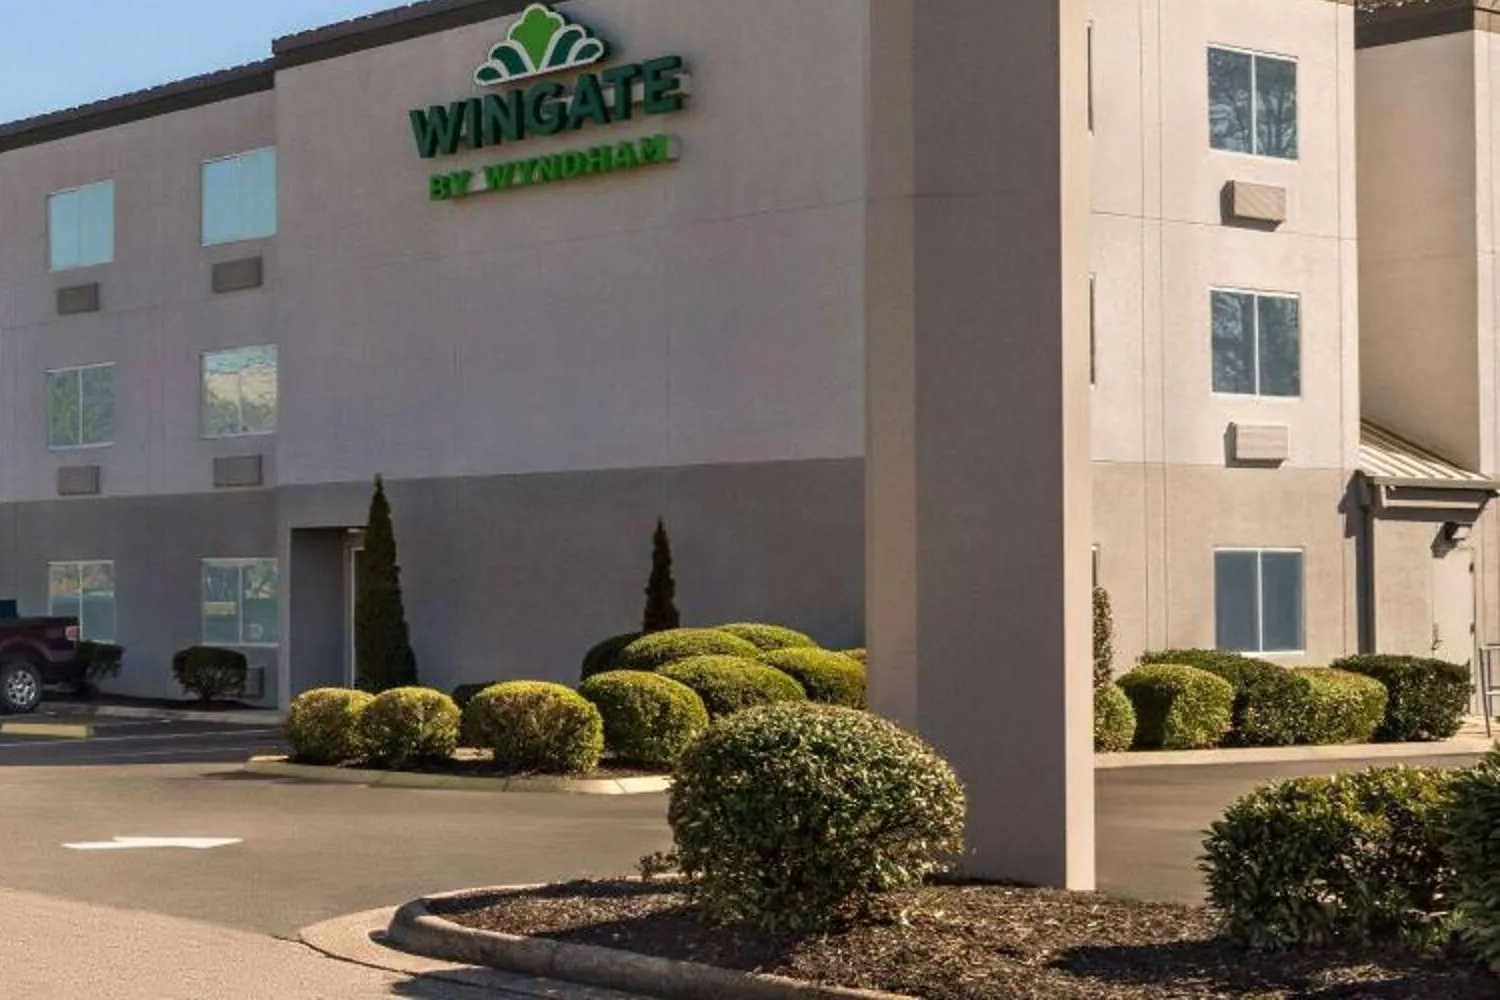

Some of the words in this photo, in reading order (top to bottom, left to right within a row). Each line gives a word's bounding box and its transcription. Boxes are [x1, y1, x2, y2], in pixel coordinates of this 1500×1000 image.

[409, 55, 684, 158] WINGATE
[430, 169, 472, 200] BY
[485, 134, 669, 190] WYNDHAM
